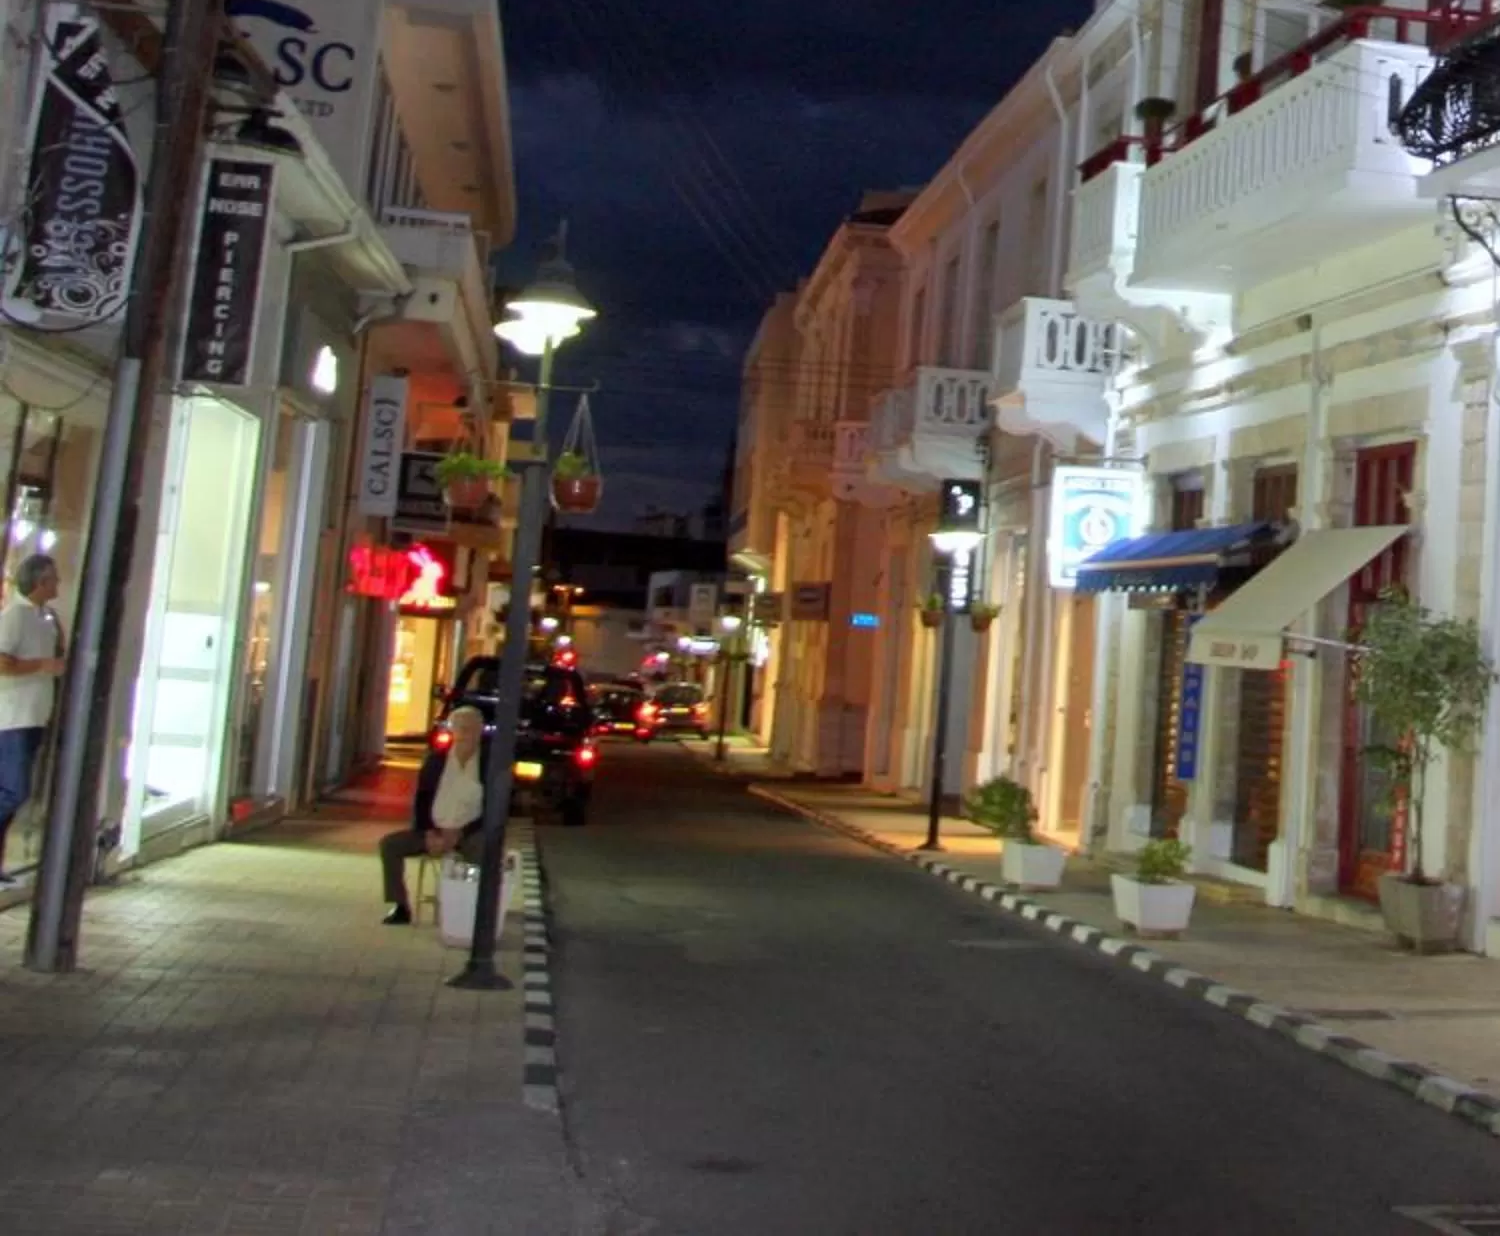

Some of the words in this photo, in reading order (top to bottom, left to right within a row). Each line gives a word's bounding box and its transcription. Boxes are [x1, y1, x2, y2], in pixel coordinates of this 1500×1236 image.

[219, 172, 261, 189] EAR
[208, 197, 263, 216] NOSE
[206, 231, 239, 374] PIERCING
